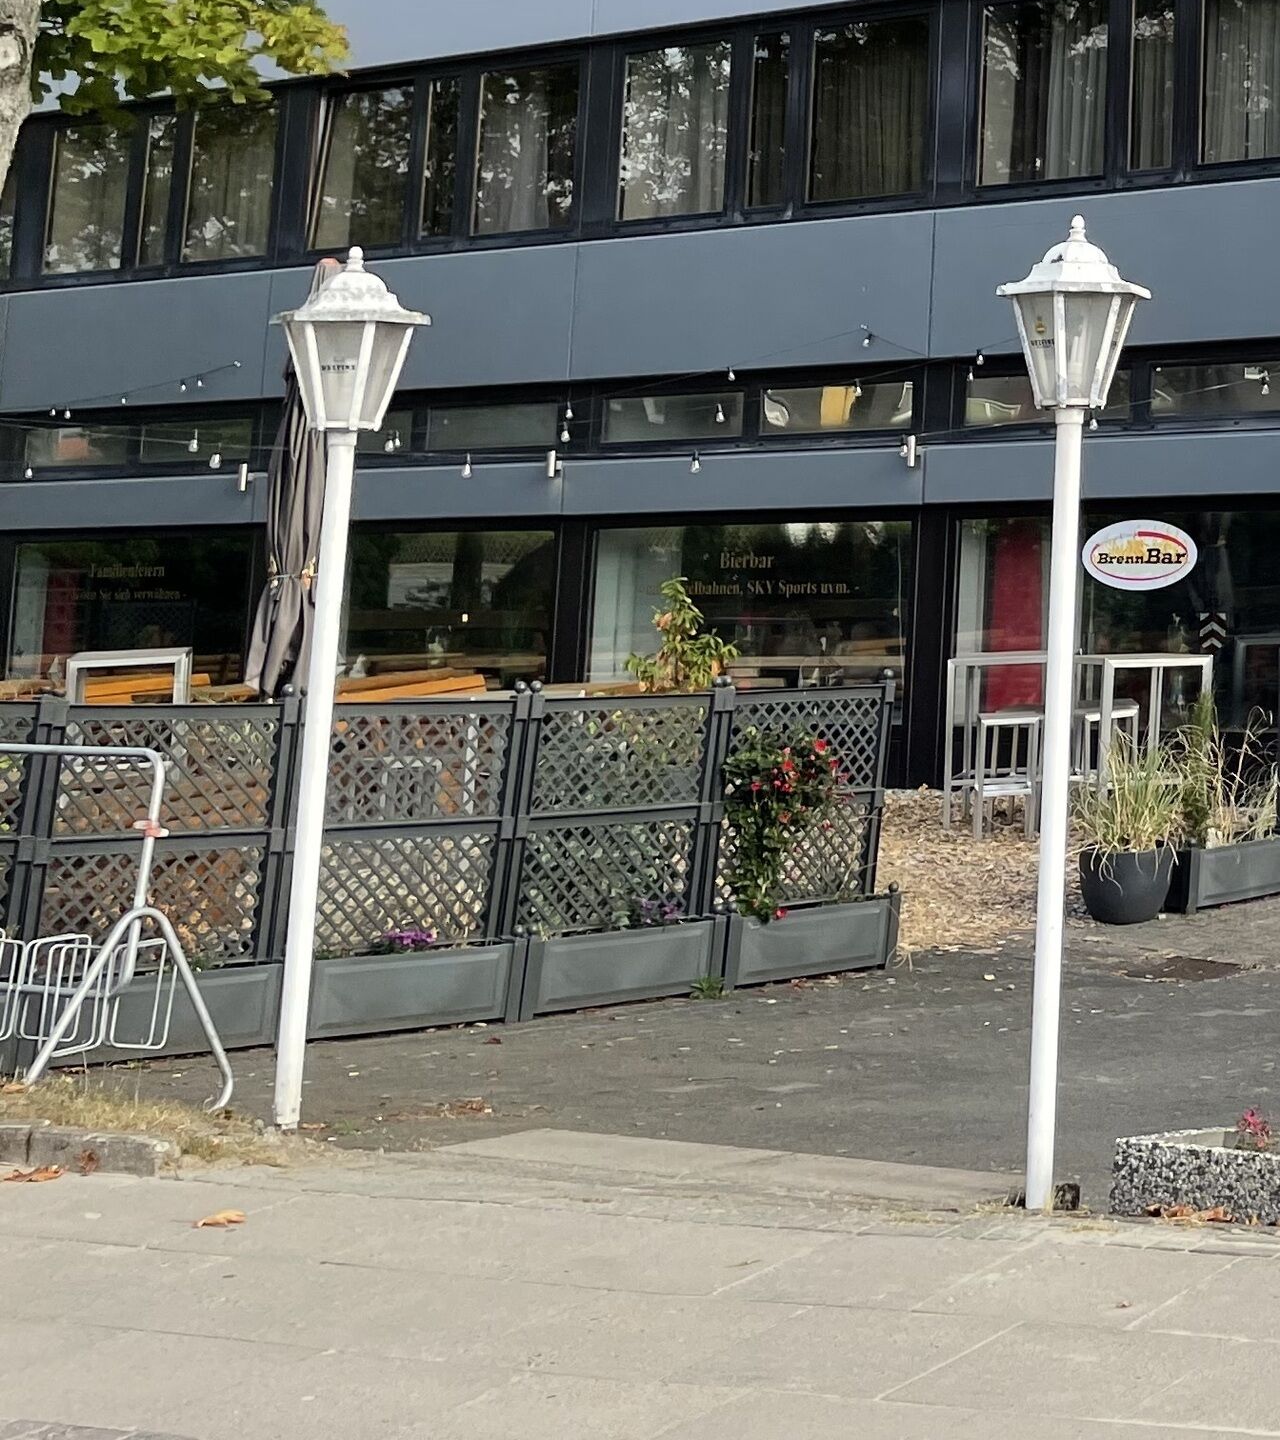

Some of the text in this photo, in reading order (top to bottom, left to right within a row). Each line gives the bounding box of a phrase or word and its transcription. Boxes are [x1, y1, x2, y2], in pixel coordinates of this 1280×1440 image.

[720, 551, 775, 570] Bierbar
[1097, 548, 1187, 564] BrennBar
[747, 580, 776, 595] SKY
[778, 580, 818, 599] Sports
[820, 584, 851, 595] uvm.
